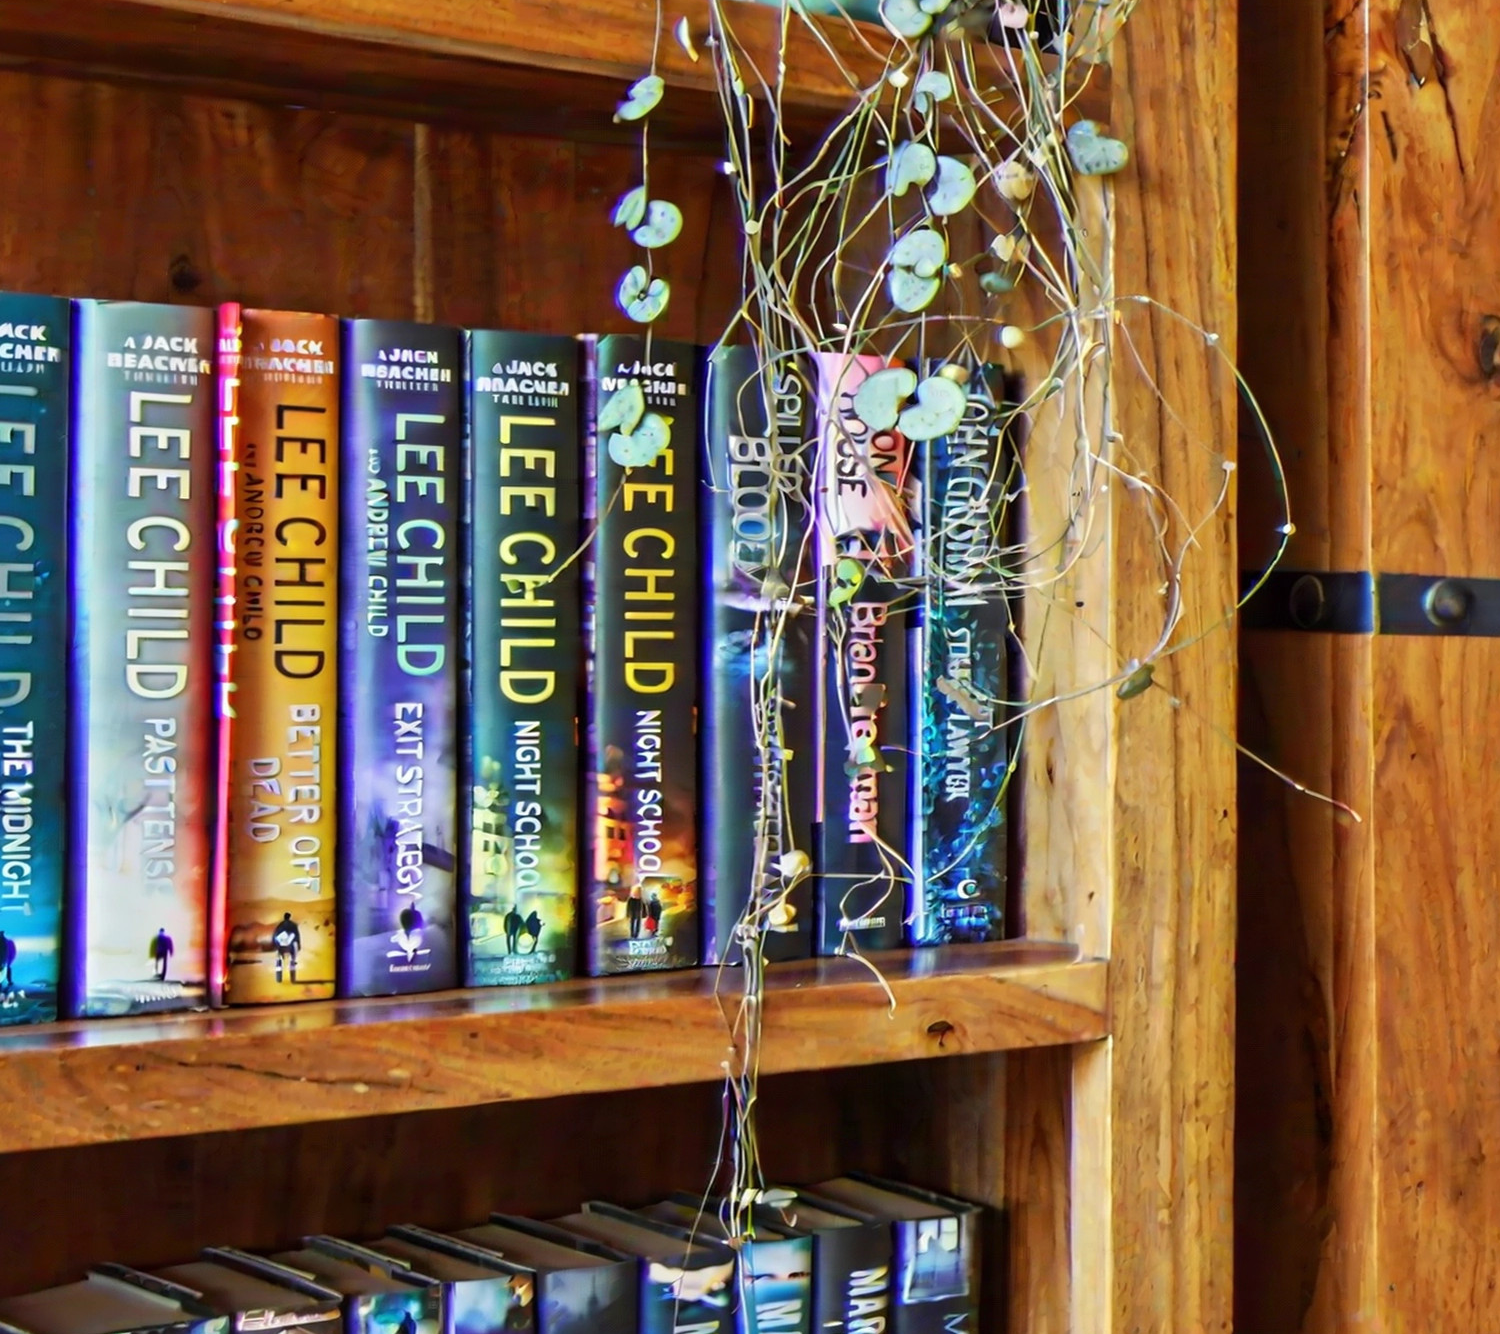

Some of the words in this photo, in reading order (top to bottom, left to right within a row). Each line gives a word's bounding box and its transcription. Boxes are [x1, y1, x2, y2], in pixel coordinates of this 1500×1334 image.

[127, 391, 193, 500] LEE
[275, 404, 326, 500] LEE
[396, 413, 444, 504] LEE
[499, 416, 556, 517] LEE
[126, 516, 192, 698] CHILD
[273, 517, 326, 679] CHILD
[396, 519, 445, 676] CHILD
[499, 532, 556, 704] CHILD
[143, 717, 176, 790] PAST
[288, 703, 322, 826] BETTER
[394, 702, 424, 759] EXIT
[513, 721, 541, 795] NIGHT
[251, 757, 281, 844] DEAD
[395, 765, 425, 899] STRATEGY
[514, 802, 542, 891] SCHOO
[290, 835, 322, 895] OFF
